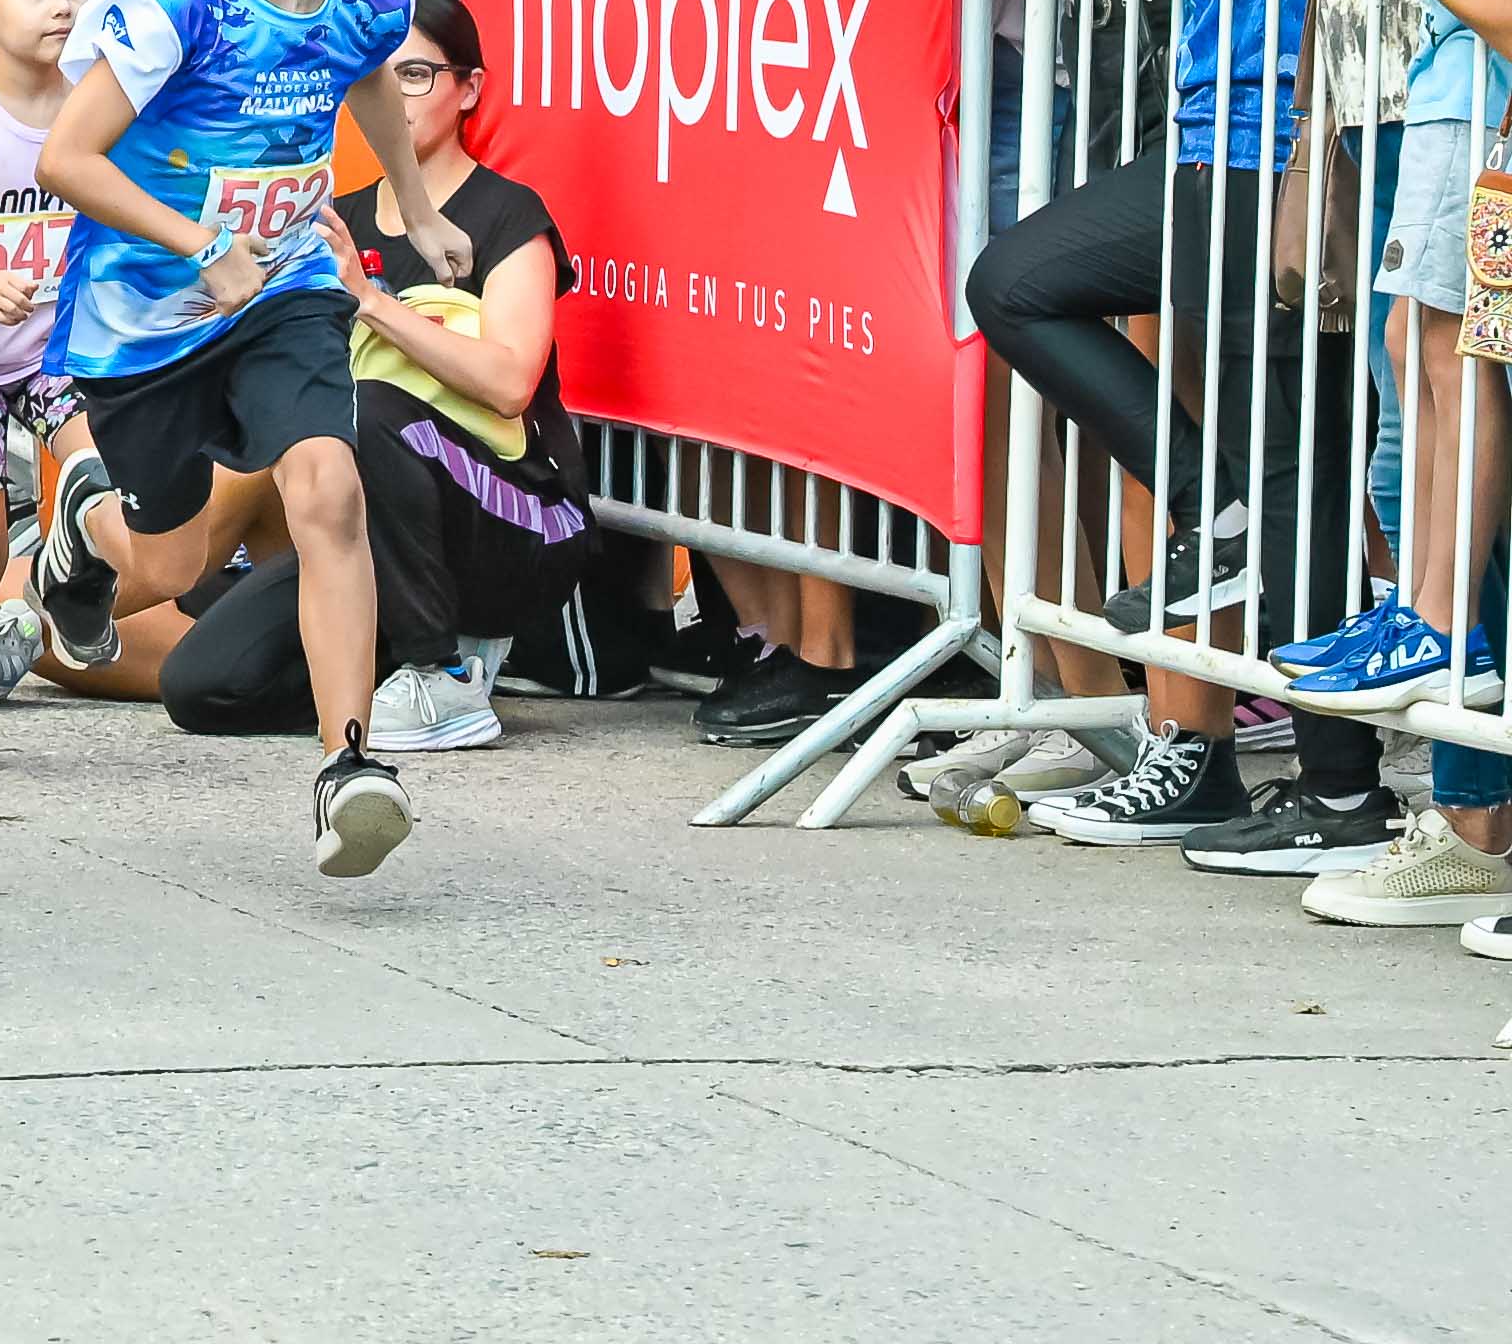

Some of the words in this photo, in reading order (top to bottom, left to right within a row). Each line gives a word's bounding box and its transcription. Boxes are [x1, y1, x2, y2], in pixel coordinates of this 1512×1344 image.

[238, 93, 335, 116] MALVINAS
[217, 168, 330, 239] 562
[688, 271, 717, 317] EN
[735, 280, 787, 332] TUS
[808, 296, 875, 356] PIES
[1366, 634, 1442, 677] FILA
[1294, 832, 1324, 846] FILA
